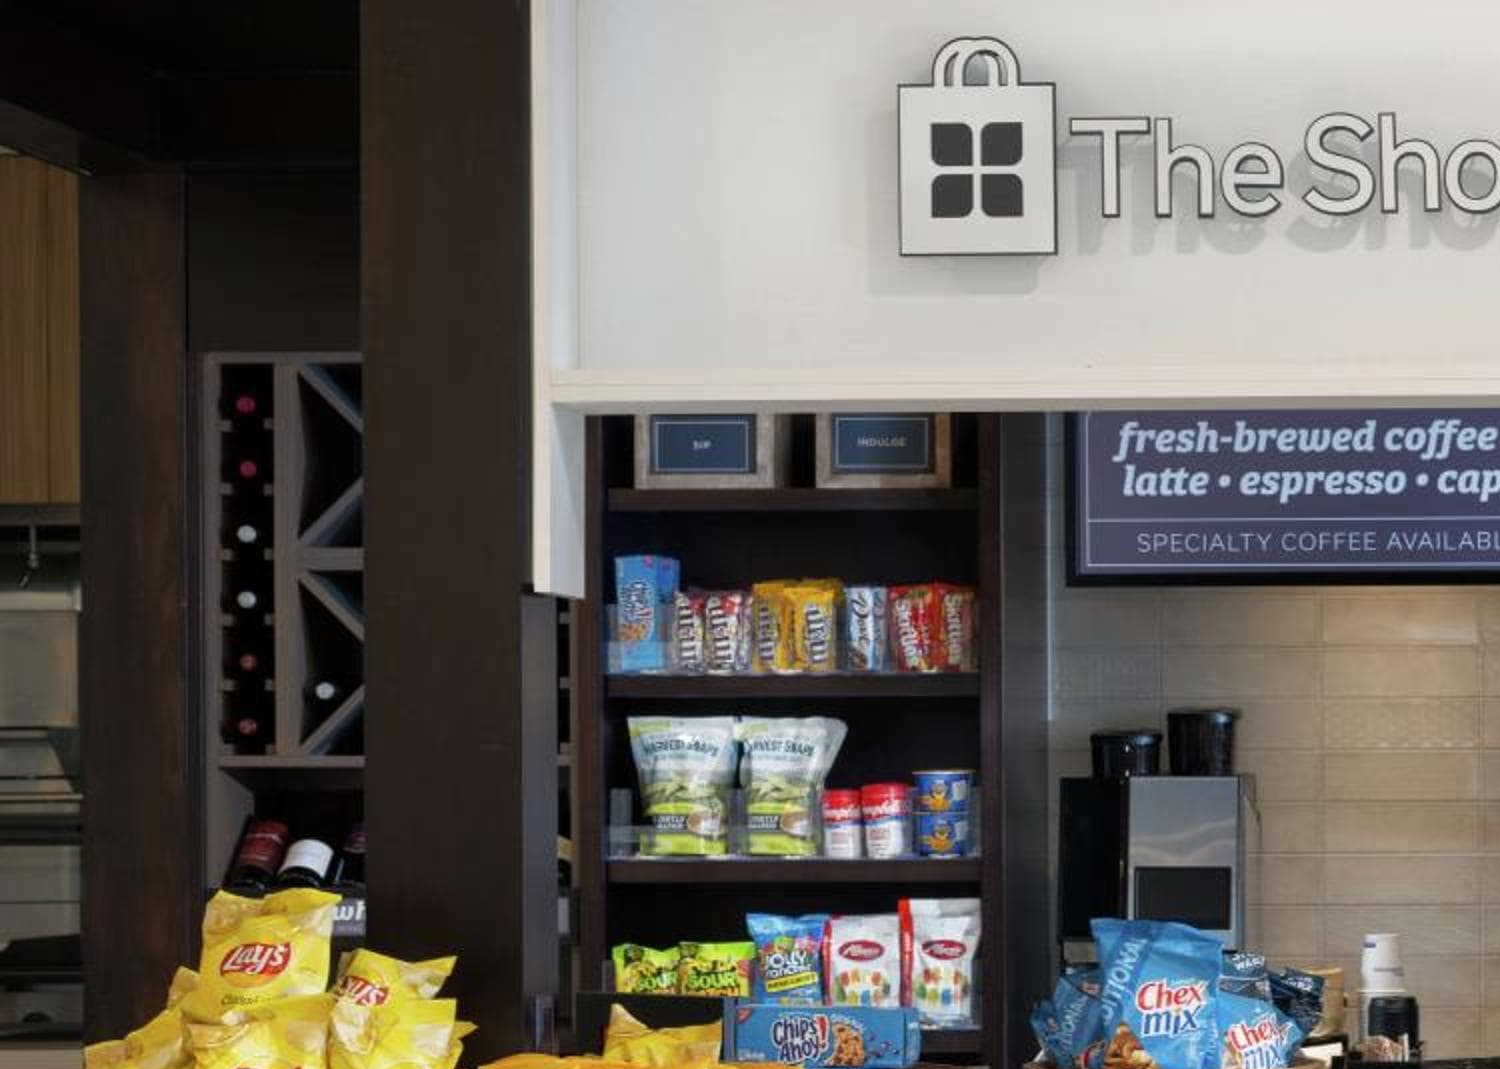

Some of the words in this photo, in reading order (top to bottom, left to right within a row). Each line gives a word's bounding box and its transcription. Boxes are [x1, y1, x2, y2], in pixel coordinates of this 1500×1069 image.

[1069, 116, 1285, 220] The
[1112, 420, 1377, 462] fresh-brewed
[1384, 418, 1499, 461] coffee
[1121, 464, 1210, 497] latte
[1239, 467, 1408, 504] espresso
[1136, 532, 1272, 554] SPECIALTY
[1281, 532, 1377, 553] COFFEE
[222, 942, 293, 975] Lay's
[765, 950, 808, 971] JOLLY
[687, 971, 737, 988] SOUR
[1136, 980, 1208, 1011] Chex
[774, 1017, 818, 1047] Chips
[1141, 1008, 1200, 1036] mix
[1228, 1013, 1288, 1050] Chex
